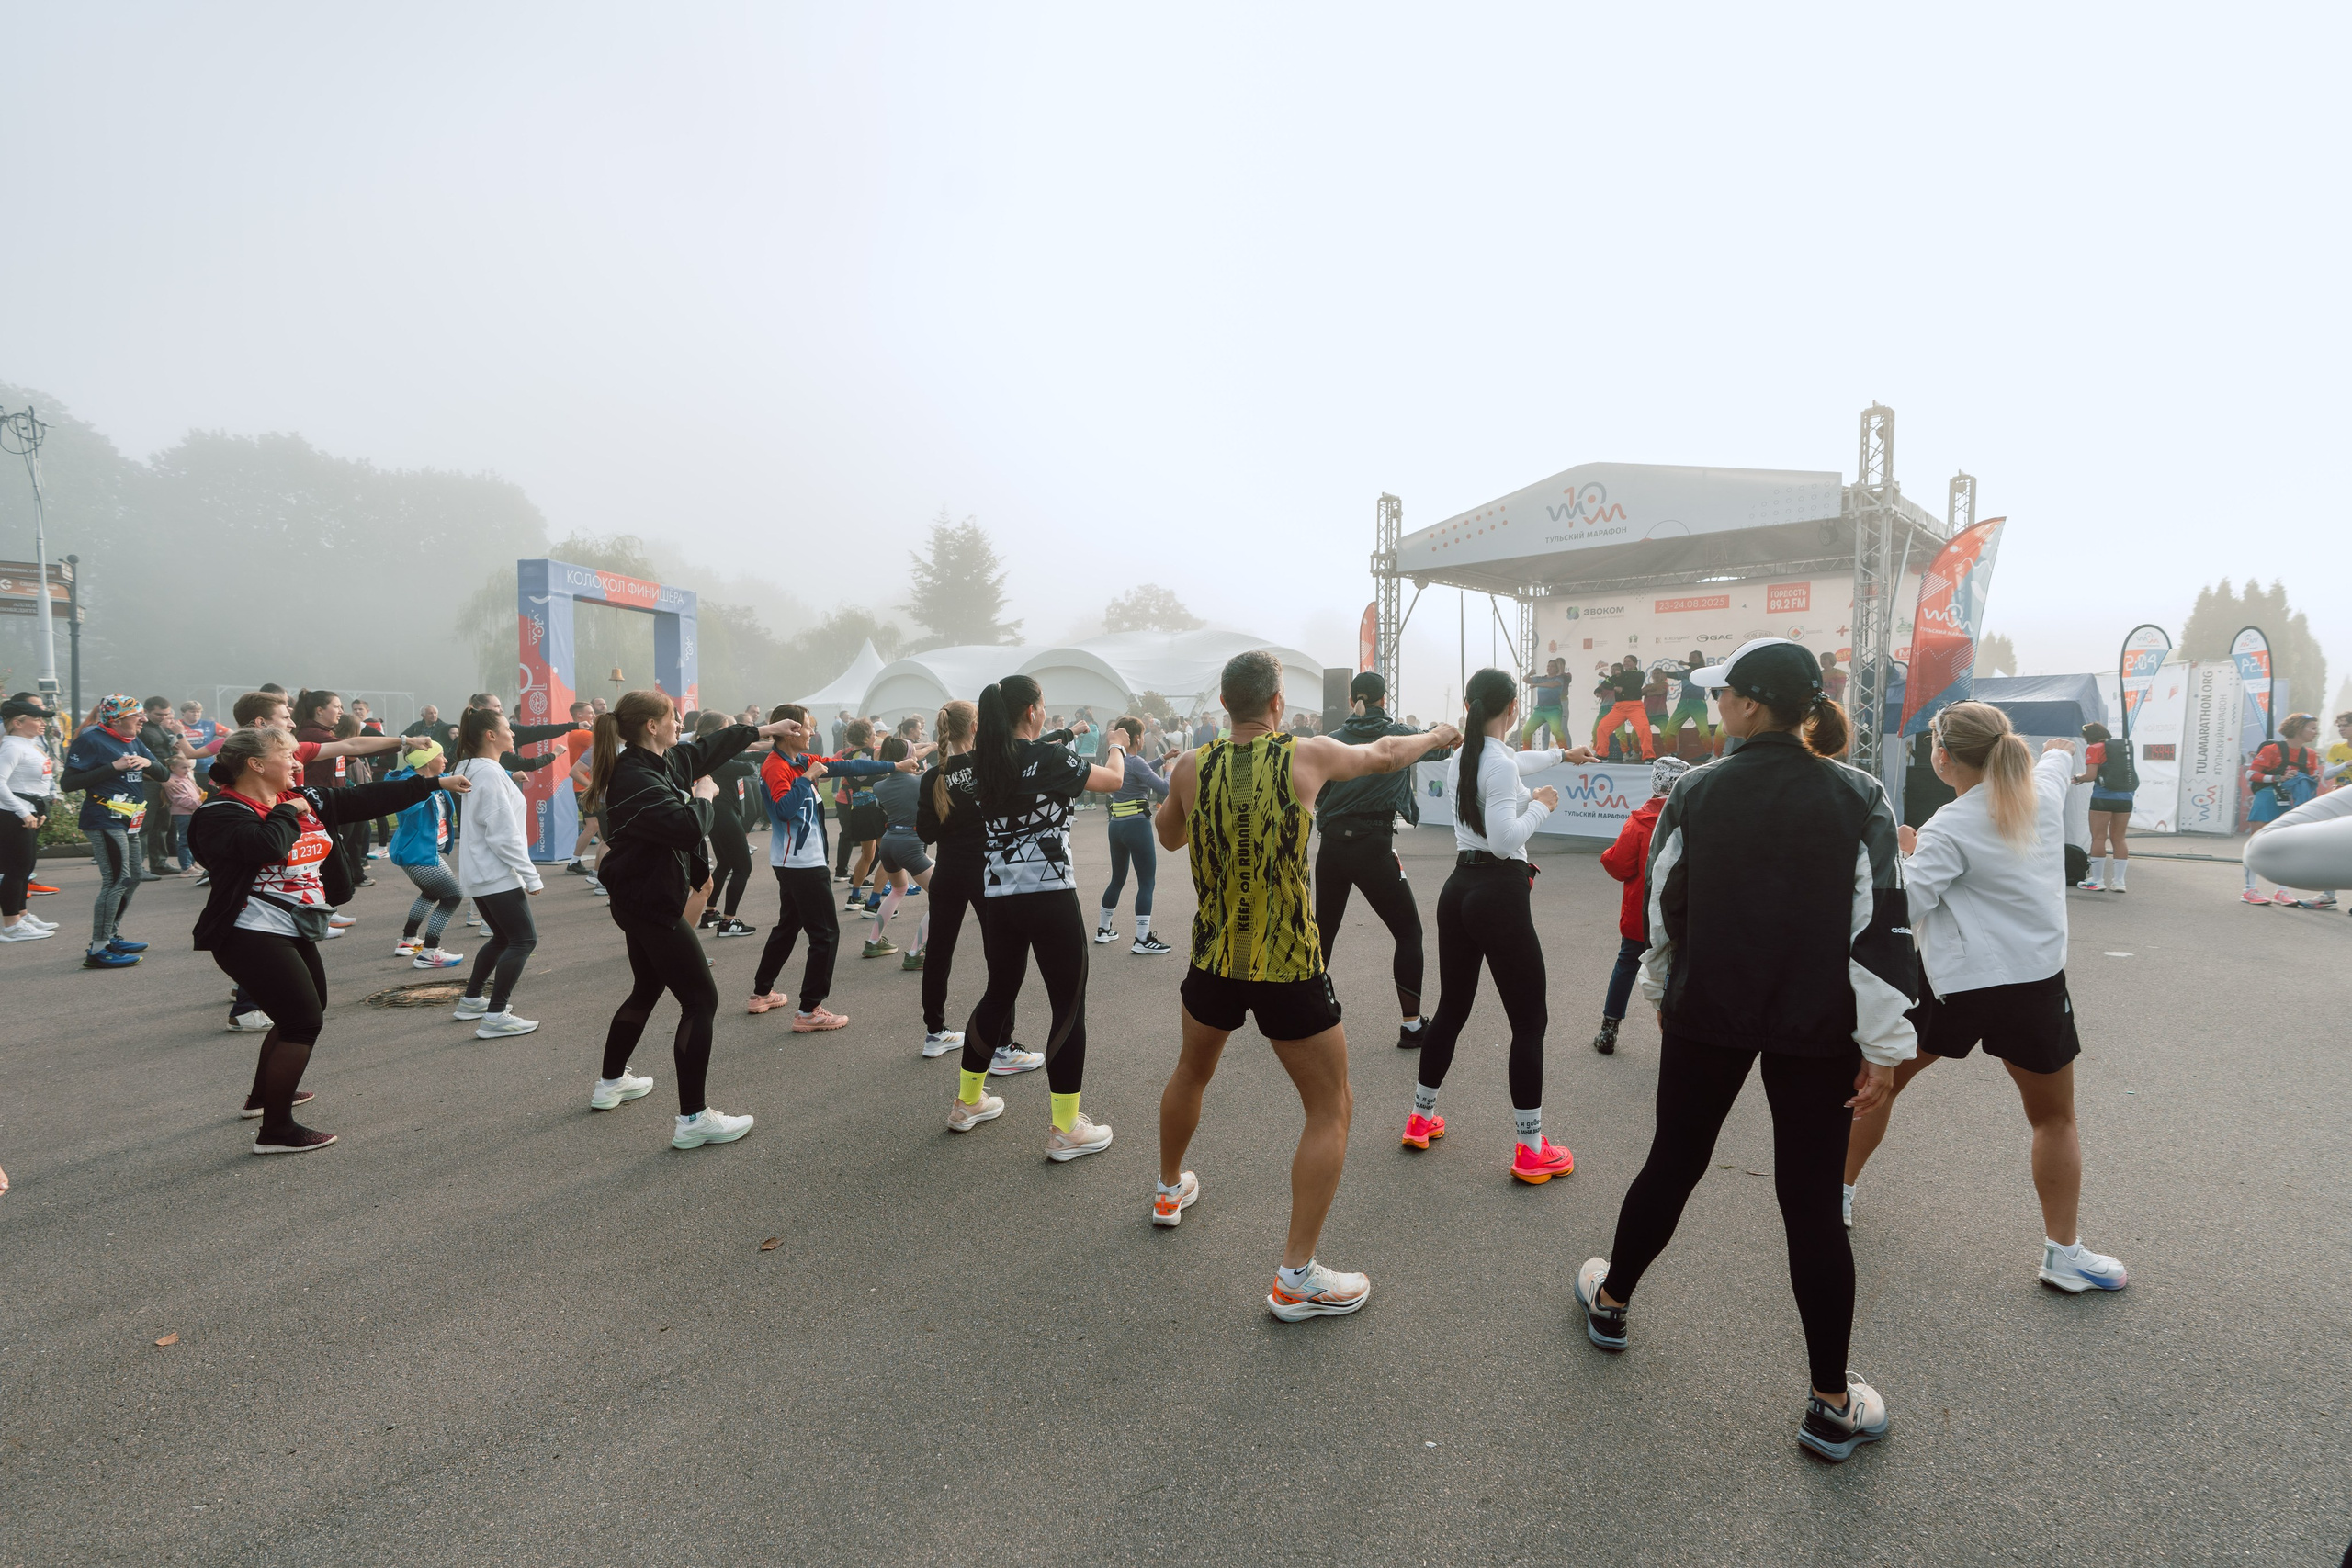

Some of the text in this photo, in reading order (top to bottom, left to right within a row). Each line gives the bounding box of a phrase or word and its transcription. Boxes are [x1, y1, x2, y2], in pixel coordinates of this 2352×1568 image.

[1545, 526, 1627, 544] ТУЛЬСКИЙ МАРАФОН
[566, 570, 685, 606] КОЛОКОЛ ФИНИШЁРА
[1583, 606, 1624, 616] ЭВОКОМ
[1658, 597, 1725, 611] 23-24.08.2025
[1770, 597, 1806, 610] 89.2 FM
[2196, 671, 2213, 775] TULAMARATHON.ORG
[300, 843, 322, 858] 2312
[1238, 802, 1251, 931] KEEP ON RUNNING
